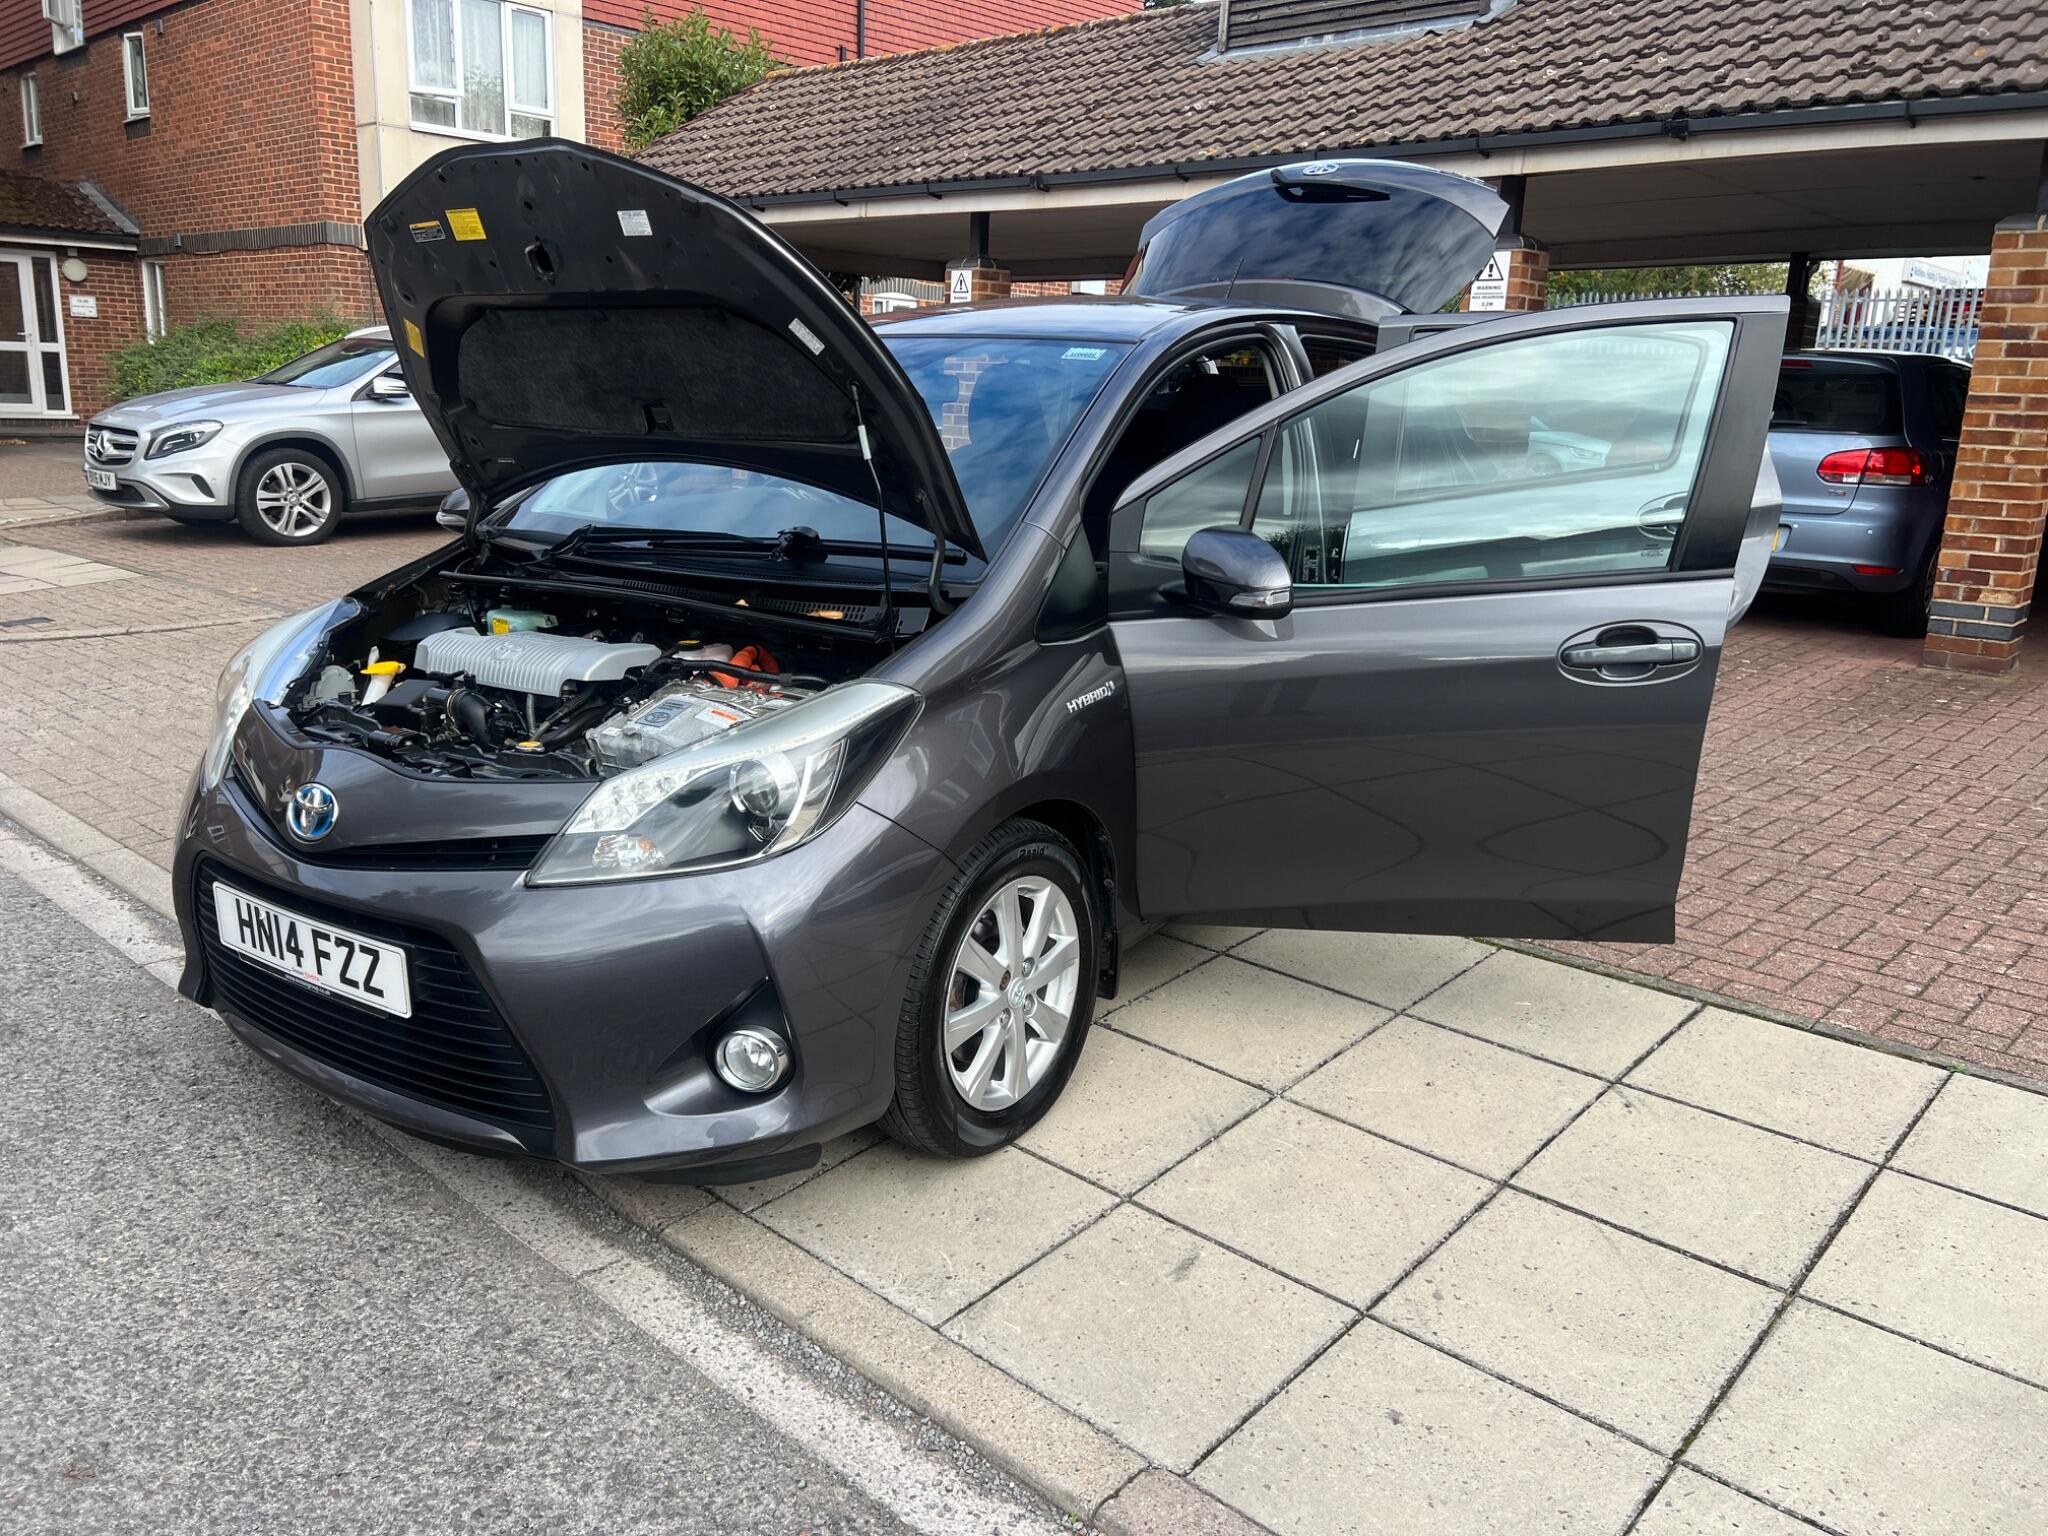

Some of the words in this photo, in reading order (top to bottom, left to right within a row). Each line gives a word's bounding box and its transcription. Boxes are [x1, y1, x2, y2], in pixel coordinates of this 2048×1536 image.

[1066, 685, 1109, 713] HYBRID
[234, 898, 304, 968] HN14
[311, 928, 385, 999] FZZ
